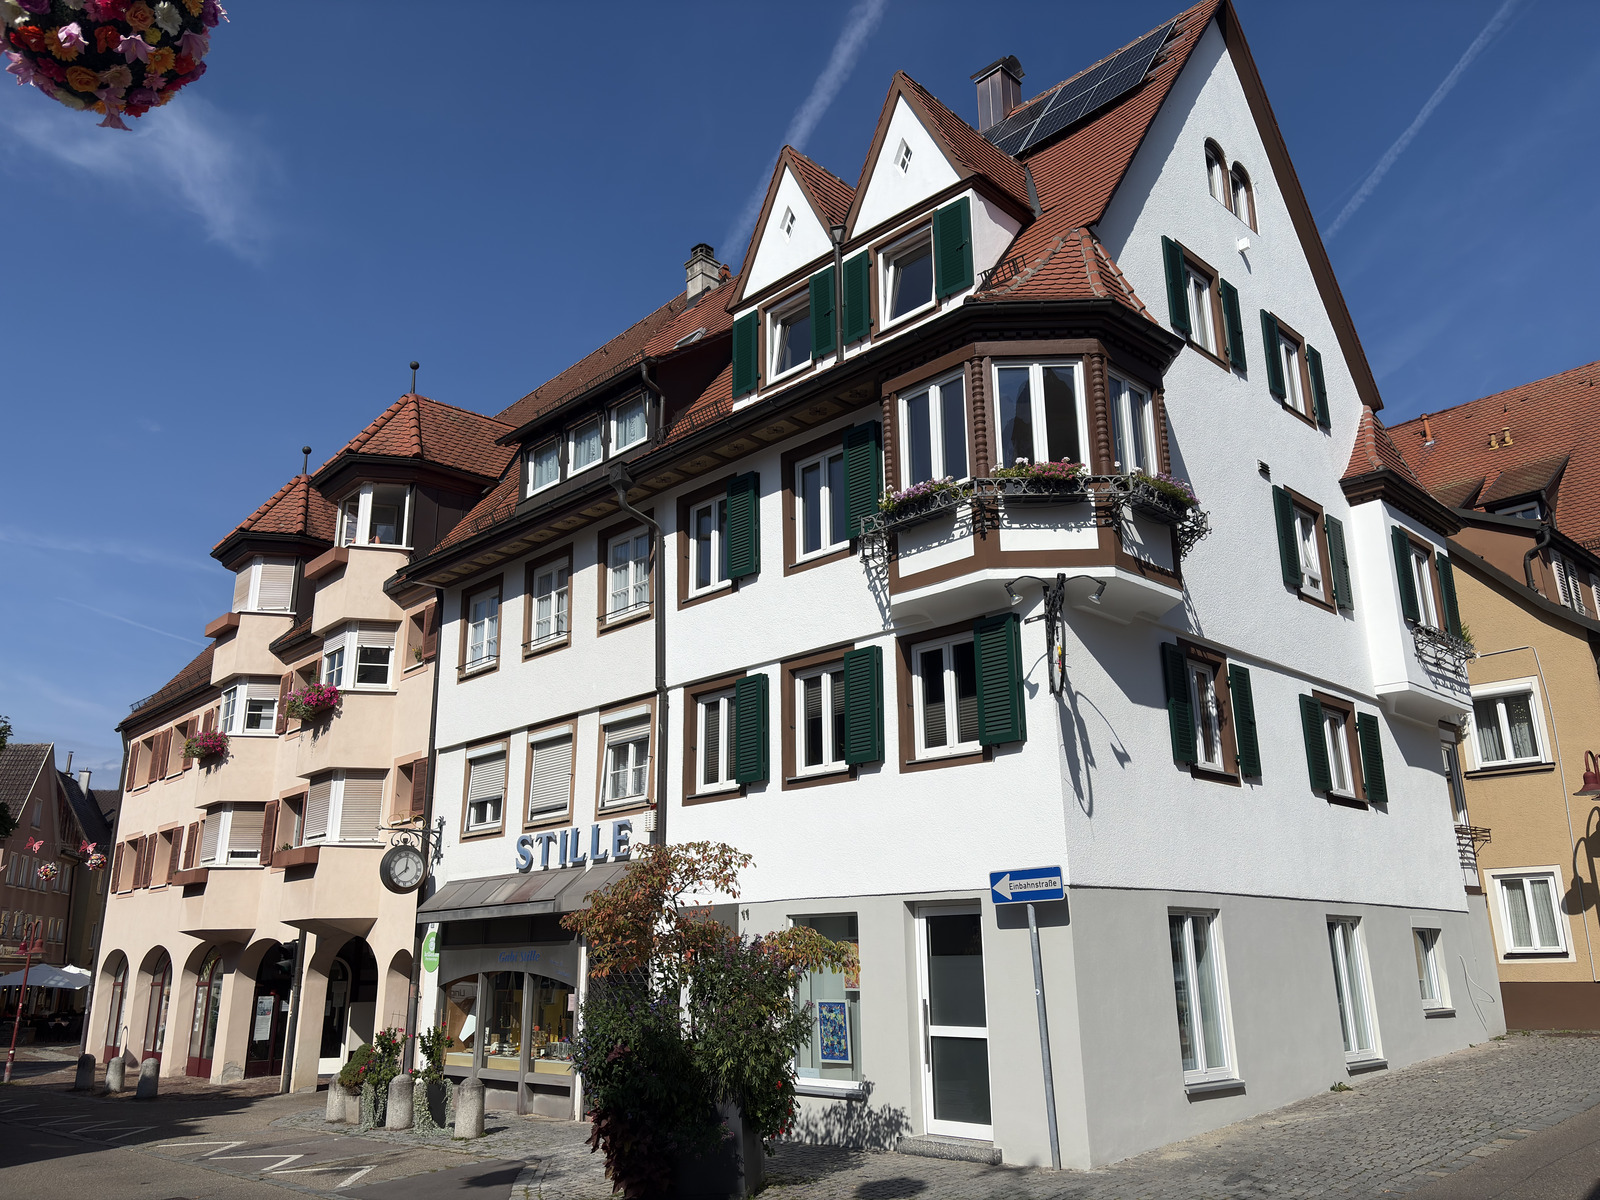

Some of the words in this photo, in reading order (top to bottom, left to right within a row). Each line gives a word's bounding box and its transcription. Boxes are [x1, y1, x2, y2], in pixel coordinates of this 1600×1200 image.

[515, 818, 633, 871] STILLE
[1009, 880, 1057, 891] Einbahnstraße
[498, 951, 518, 962] Gabi
[519, 950, 541, 962] Stille
